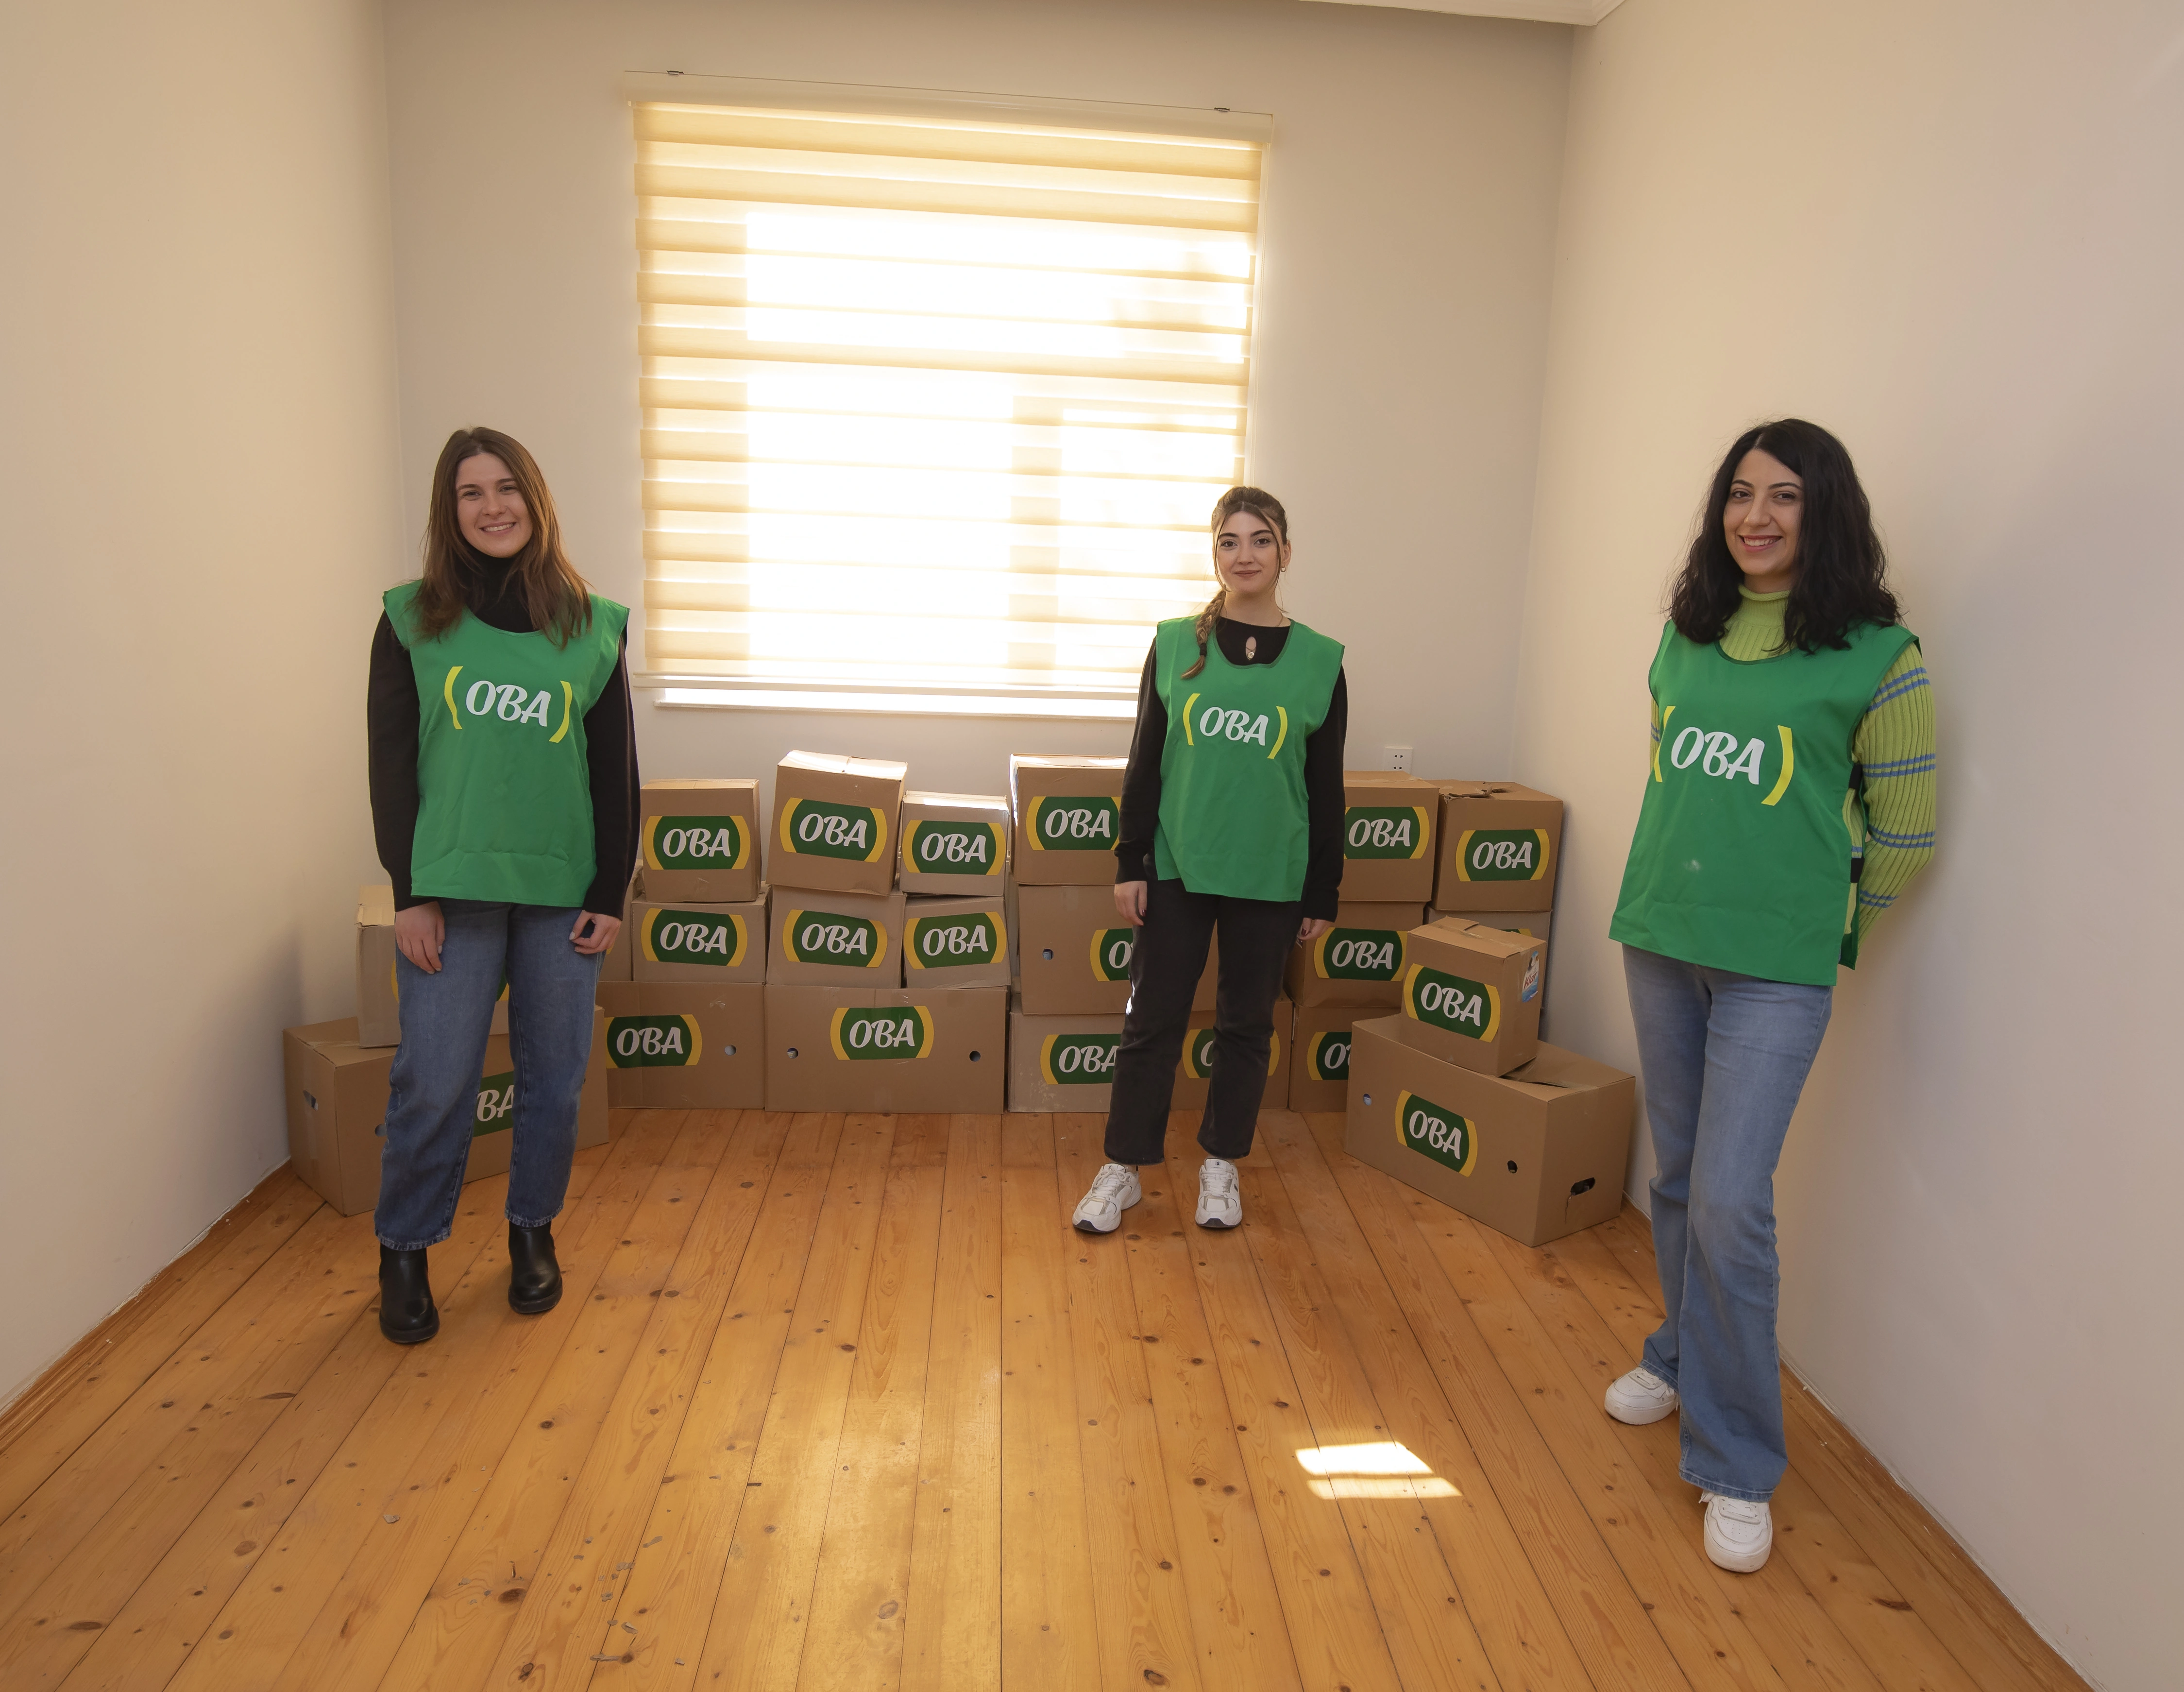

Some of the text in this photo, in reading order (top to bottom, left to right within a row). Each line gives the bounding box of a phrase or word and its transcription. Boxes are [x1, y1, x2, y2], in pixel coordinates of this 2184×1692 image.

[799, 814, 867, 848] OBA
[1045, 809, 1110, 837] OBA
[1349, 819, 1410, 847] OBA
[663, 828, 730, 857] OBA
[921, 833, 986, 863] OBA
[1473, 842, 1532, 869] OBA
[660, 923, 727, 954] OBA
[802, 924, 867, 955] OBA
[923, 925, 988, 956] OBA
[1332, 940, 1393, 969] OBA
[1421, 983, 1482, 1026] OBA
[617, 1027, 683, 1056] OBA
[849, 1019, 914, 1048] OBA
[477, 1085, 513, 1121] BA
[1409, 1111, 1461, 1159] OBA
